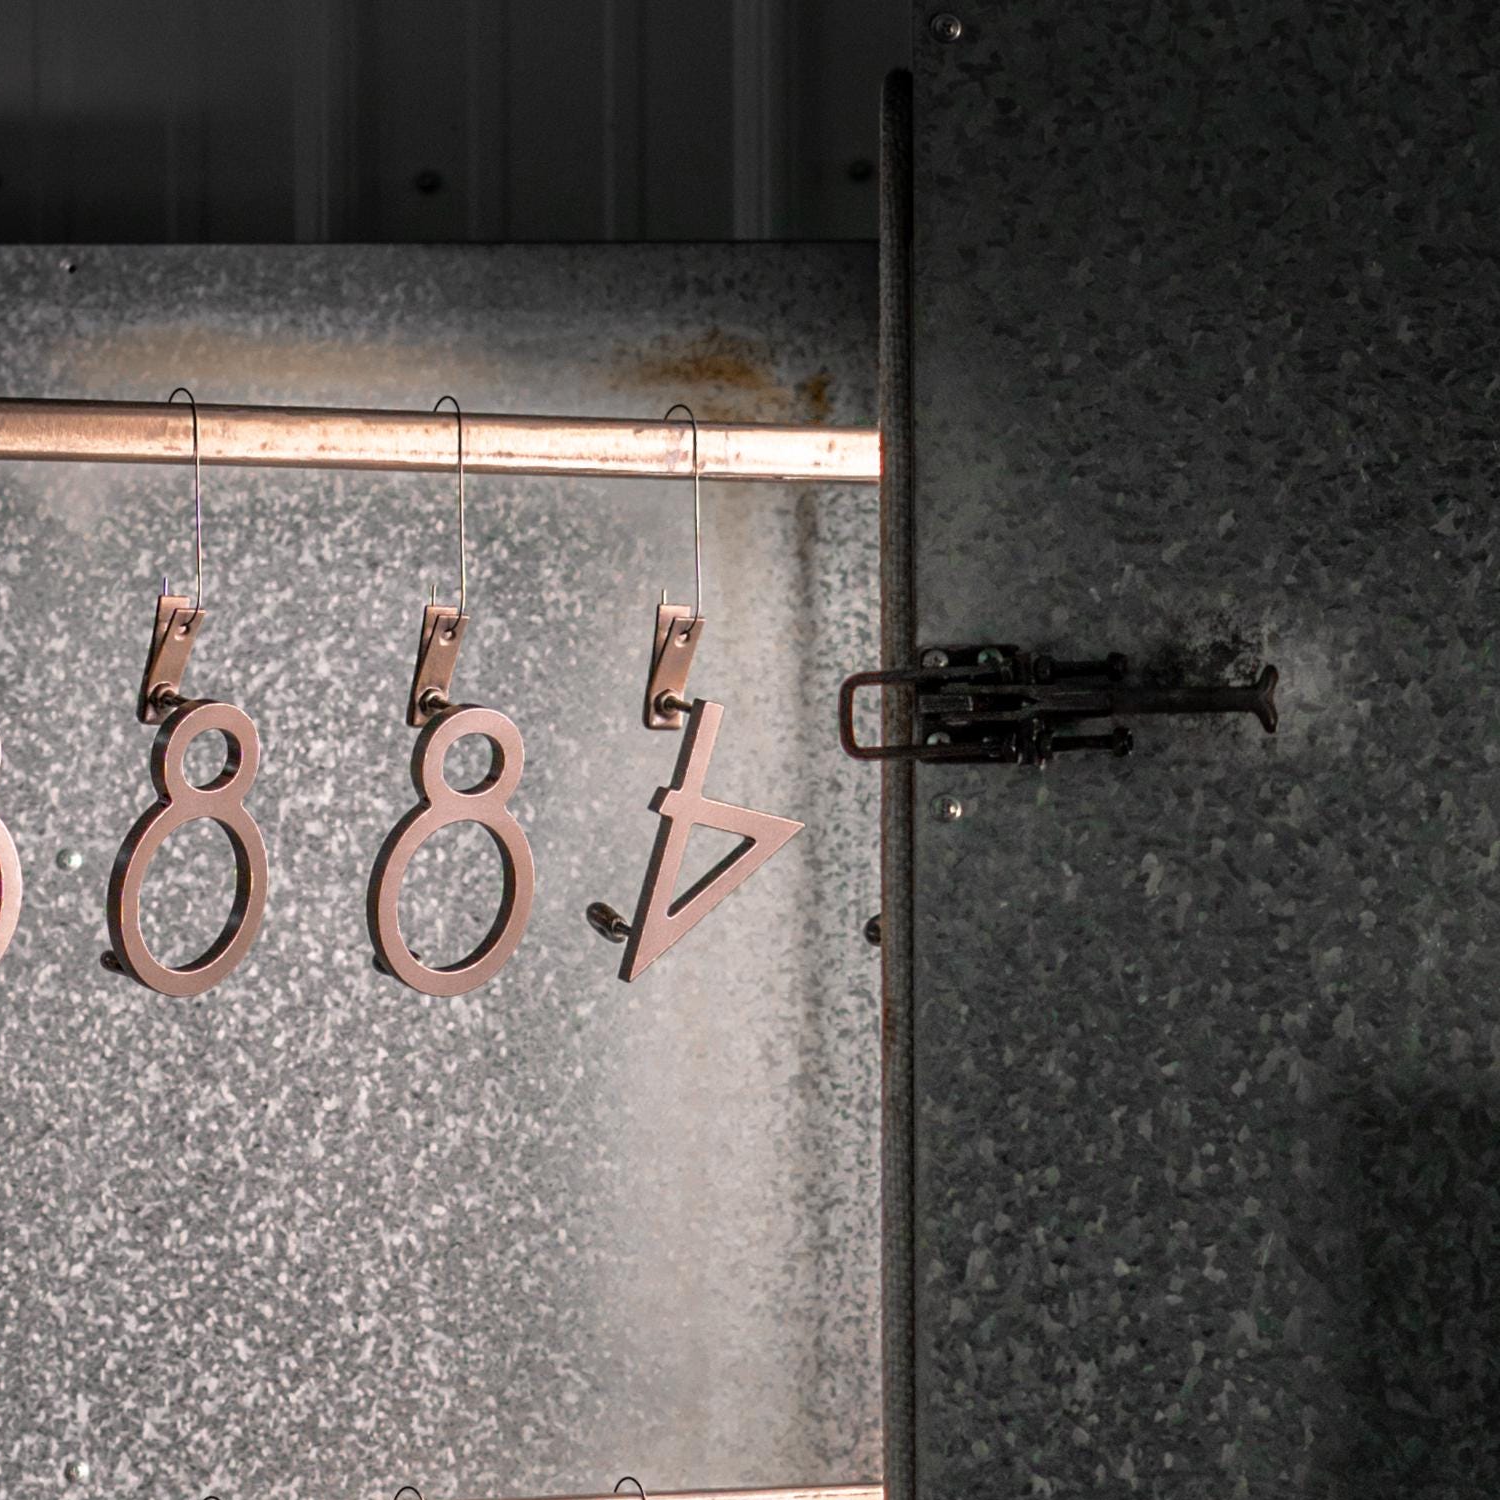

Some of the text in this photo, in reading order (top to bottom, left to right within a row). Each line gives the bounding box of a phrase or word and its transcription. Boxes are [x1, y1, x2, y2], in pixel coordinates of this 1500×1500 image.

[107, 701, 269, 997] 8
[367, 705, 536, 997] 8
[618, 698, 806, 983] 4
